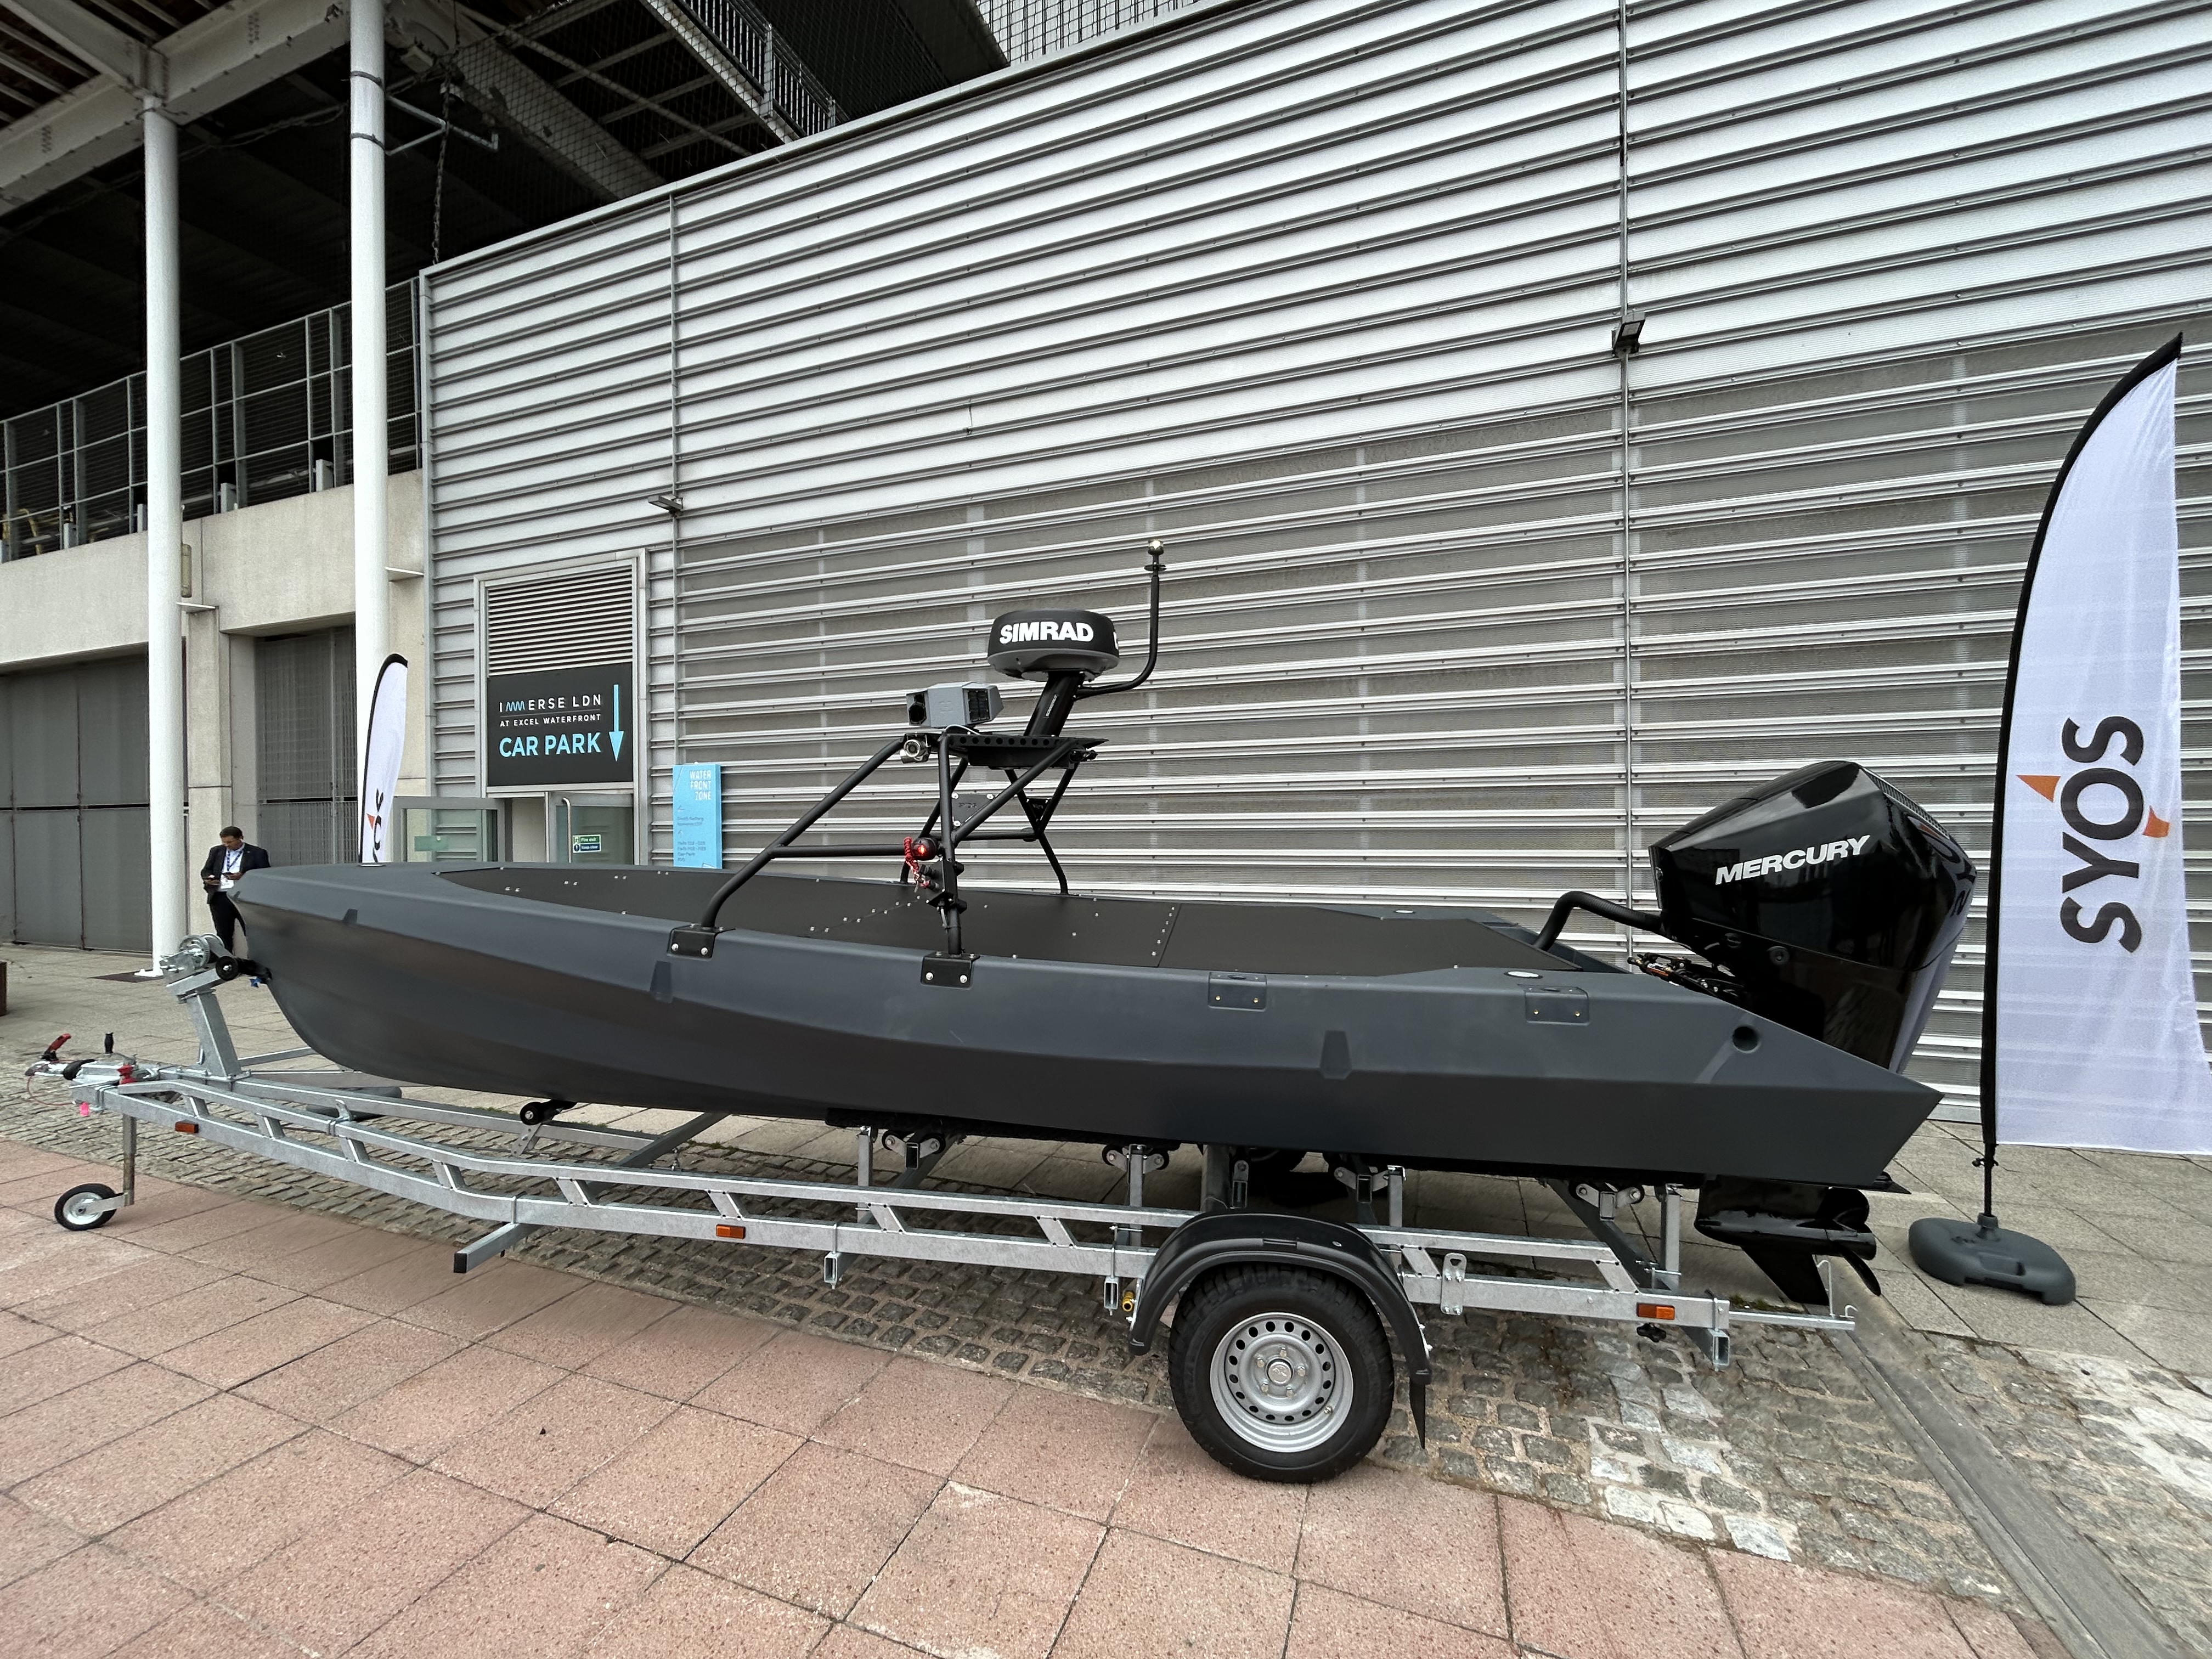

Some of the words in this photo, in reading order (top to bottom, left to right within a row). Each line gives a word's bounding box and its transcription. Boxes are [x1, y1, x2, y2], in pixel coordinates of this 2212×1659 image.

[999, 621, 1094, 645] SIMRAD
[572, 693, 601, 707] LDN
[513, 718, 539, 726] EXCEL
[543, 713, 602, 725] WATERFRONT
[499, 736, 539, 757] CAR
[545, 732, 602, 755] PARK
[690, 770, 712, 780] WATER
[690, 780, 712, 791] FRONT
[695, 791, 712, 800] ZONE
[2060, 715, 2145, 953] SYOS
[1715, 834, 1871, 885] MERCURY
